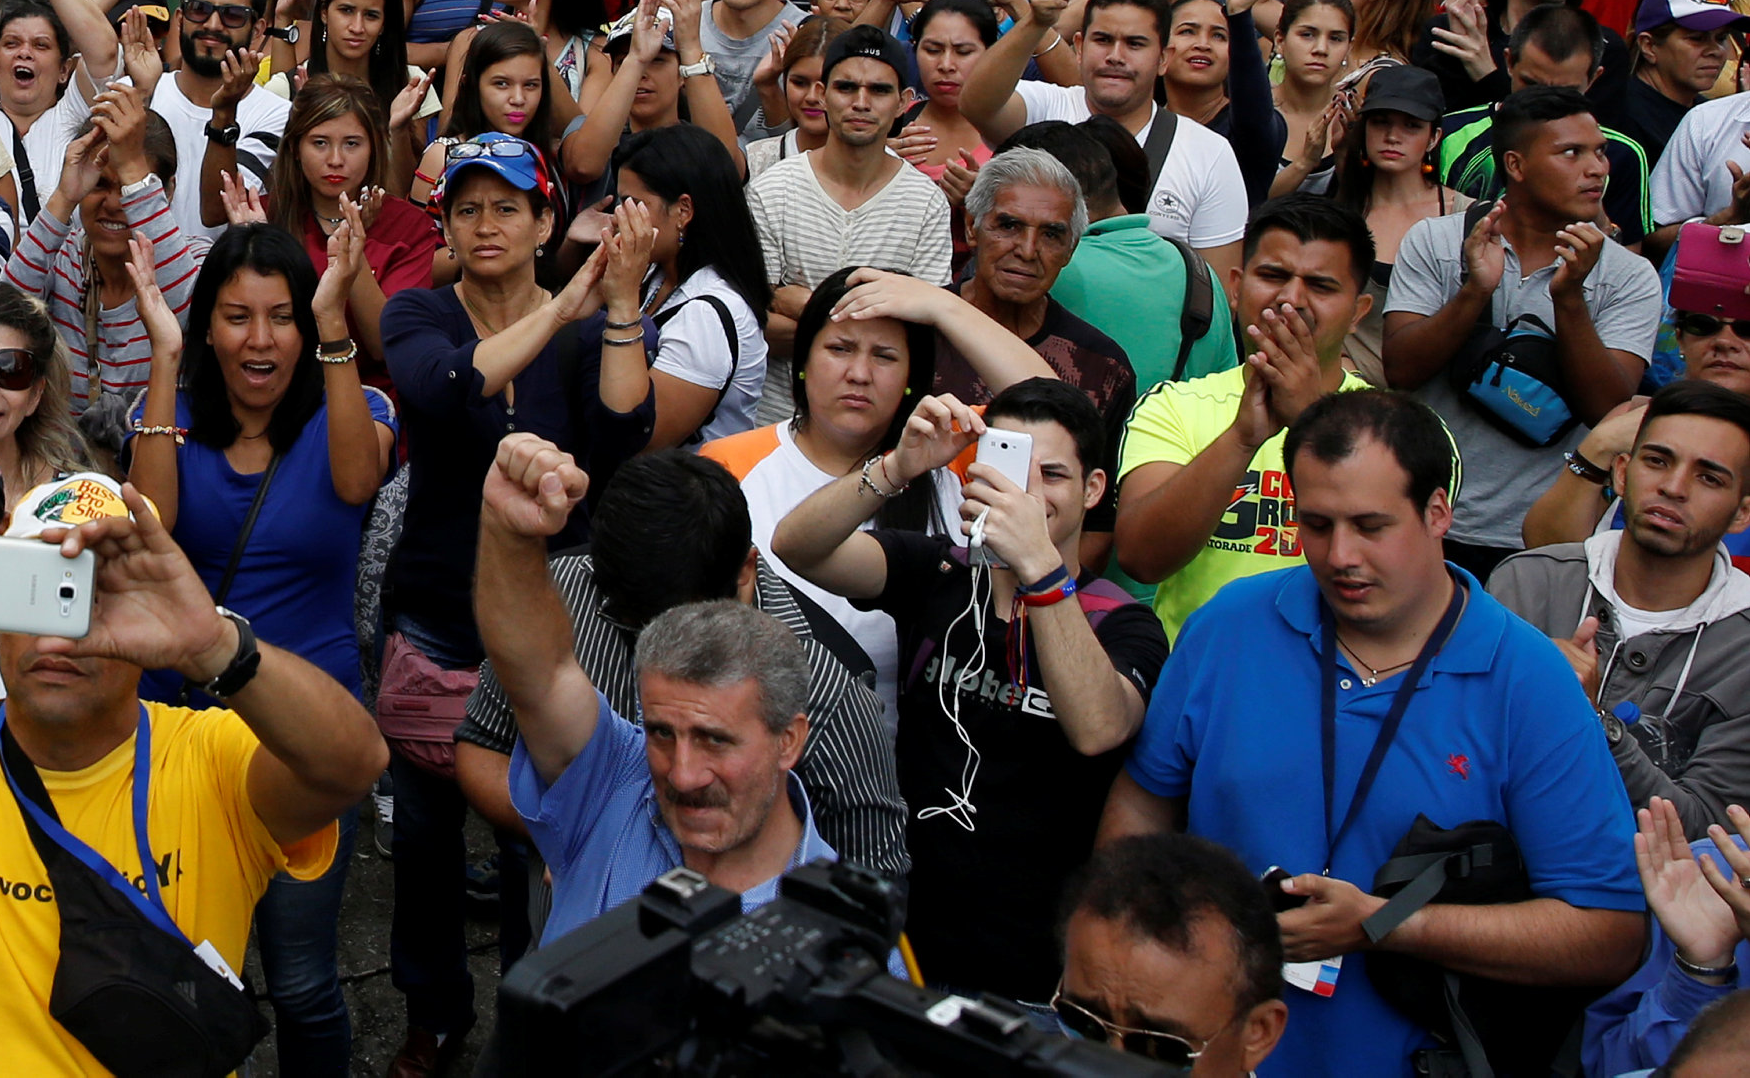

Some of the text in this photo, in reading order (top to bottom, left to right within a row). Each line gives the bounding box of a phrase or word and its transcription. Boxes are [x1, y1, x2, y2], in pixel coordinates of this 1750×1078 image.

[76, 479, 116, 502] Bass
[76, 493, 105, 509] Pro
[924, 655, 1024, 707] globe
